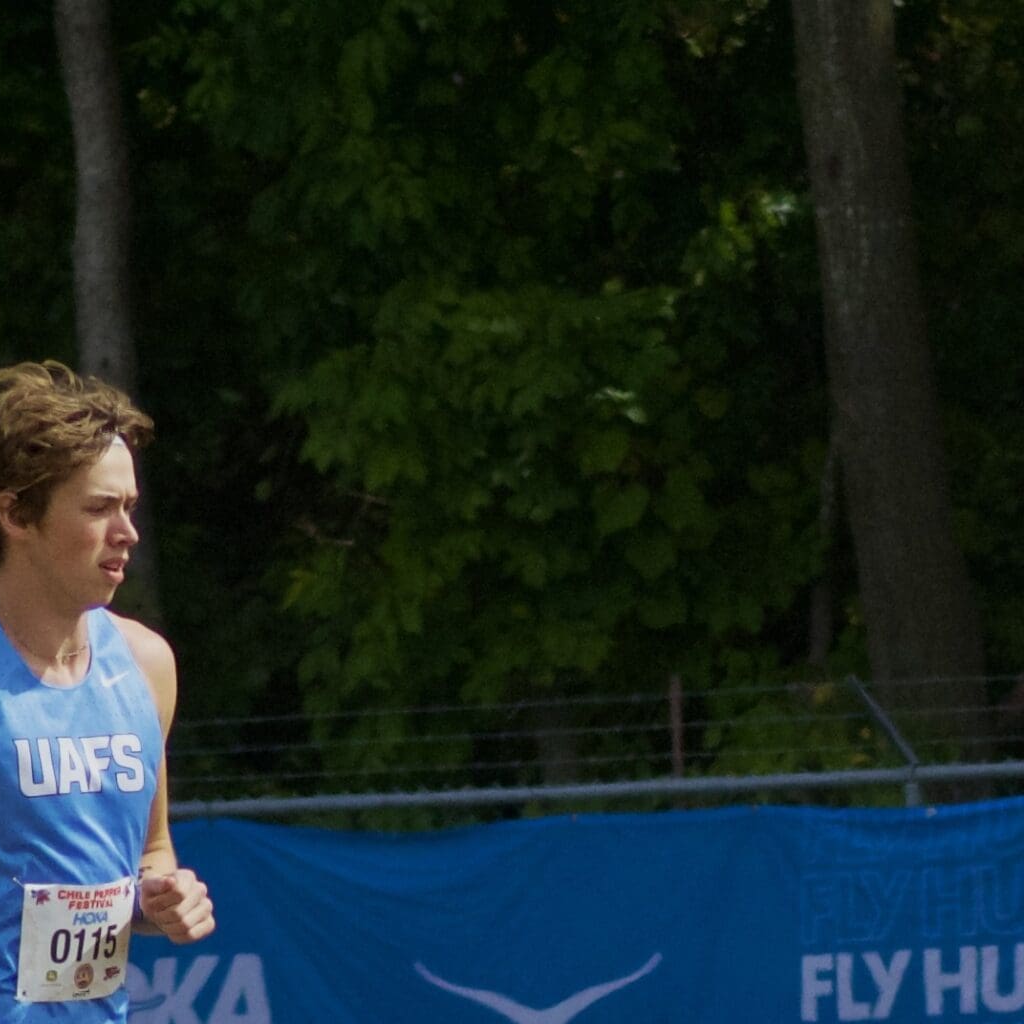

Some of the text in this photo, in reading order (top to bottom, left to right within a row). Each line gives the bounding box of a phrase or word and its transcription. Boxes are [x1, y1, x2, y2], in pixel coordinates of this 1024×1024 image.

[12, 732, 146, 798] UAFS
[58, 889, 91, 900] CHILE
[68, 899, 113, 911] FESTIVAL
[50, 924, 118, 964] 0115
[800, 949, 913, 1022] FLY
